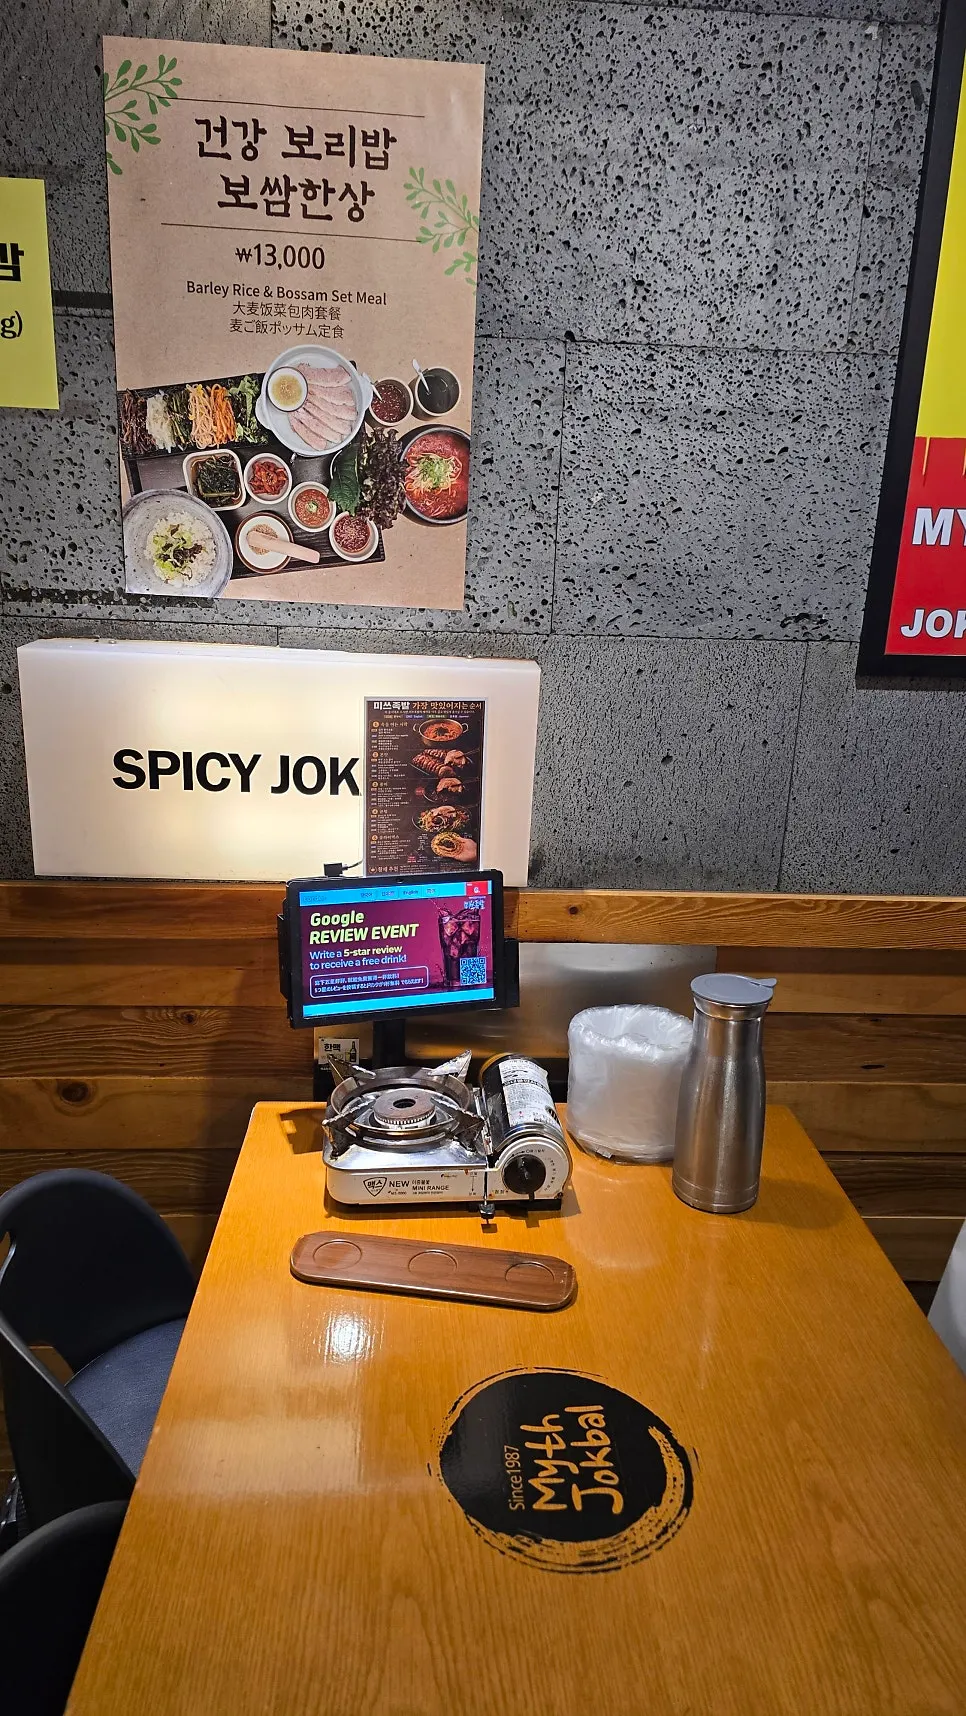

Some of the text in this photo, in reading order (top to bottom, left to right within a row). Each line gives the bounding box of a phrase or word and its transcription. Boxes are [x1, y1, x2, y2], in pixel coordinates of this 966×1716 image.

[195, 115, 397, 170] 건강 보리밥
[217, 174, 375, 223] 보쌈한상
[235, 243, 326, 270] ₩13,000
[186, 281, 387, 305] Barley Rice & Bossam Set Meal
[232, 301, 342, 321] 大麦饭菜包肉套餐
[229, 318, 345, 339] 麦ご飯ポッサム定食
[373, 701, 411, 710] 미쓰족발
[412, 702, 428, 710] 가장
[430, 702, 468, 710] 맛있어지는
[112, 748, 262, 793] SPICY
[270, 755, 362, 796] JOK
[310, 910, 365, 927] Google
[309, 923, 420, 945] REVIEW EVENT
[309, 945, 403, 960] Write a 5-star review
[309, 954, 407, 970] to receive a free drink!
[324, 1043, 341, 1052] 한맥
[367, 1180, 383, 1189] 맥스
[388, 1180, 410, 1188] NEW
[519, 1413, 579, 1511] Myth
[564, 1405, 624, 1514] Jokbal
